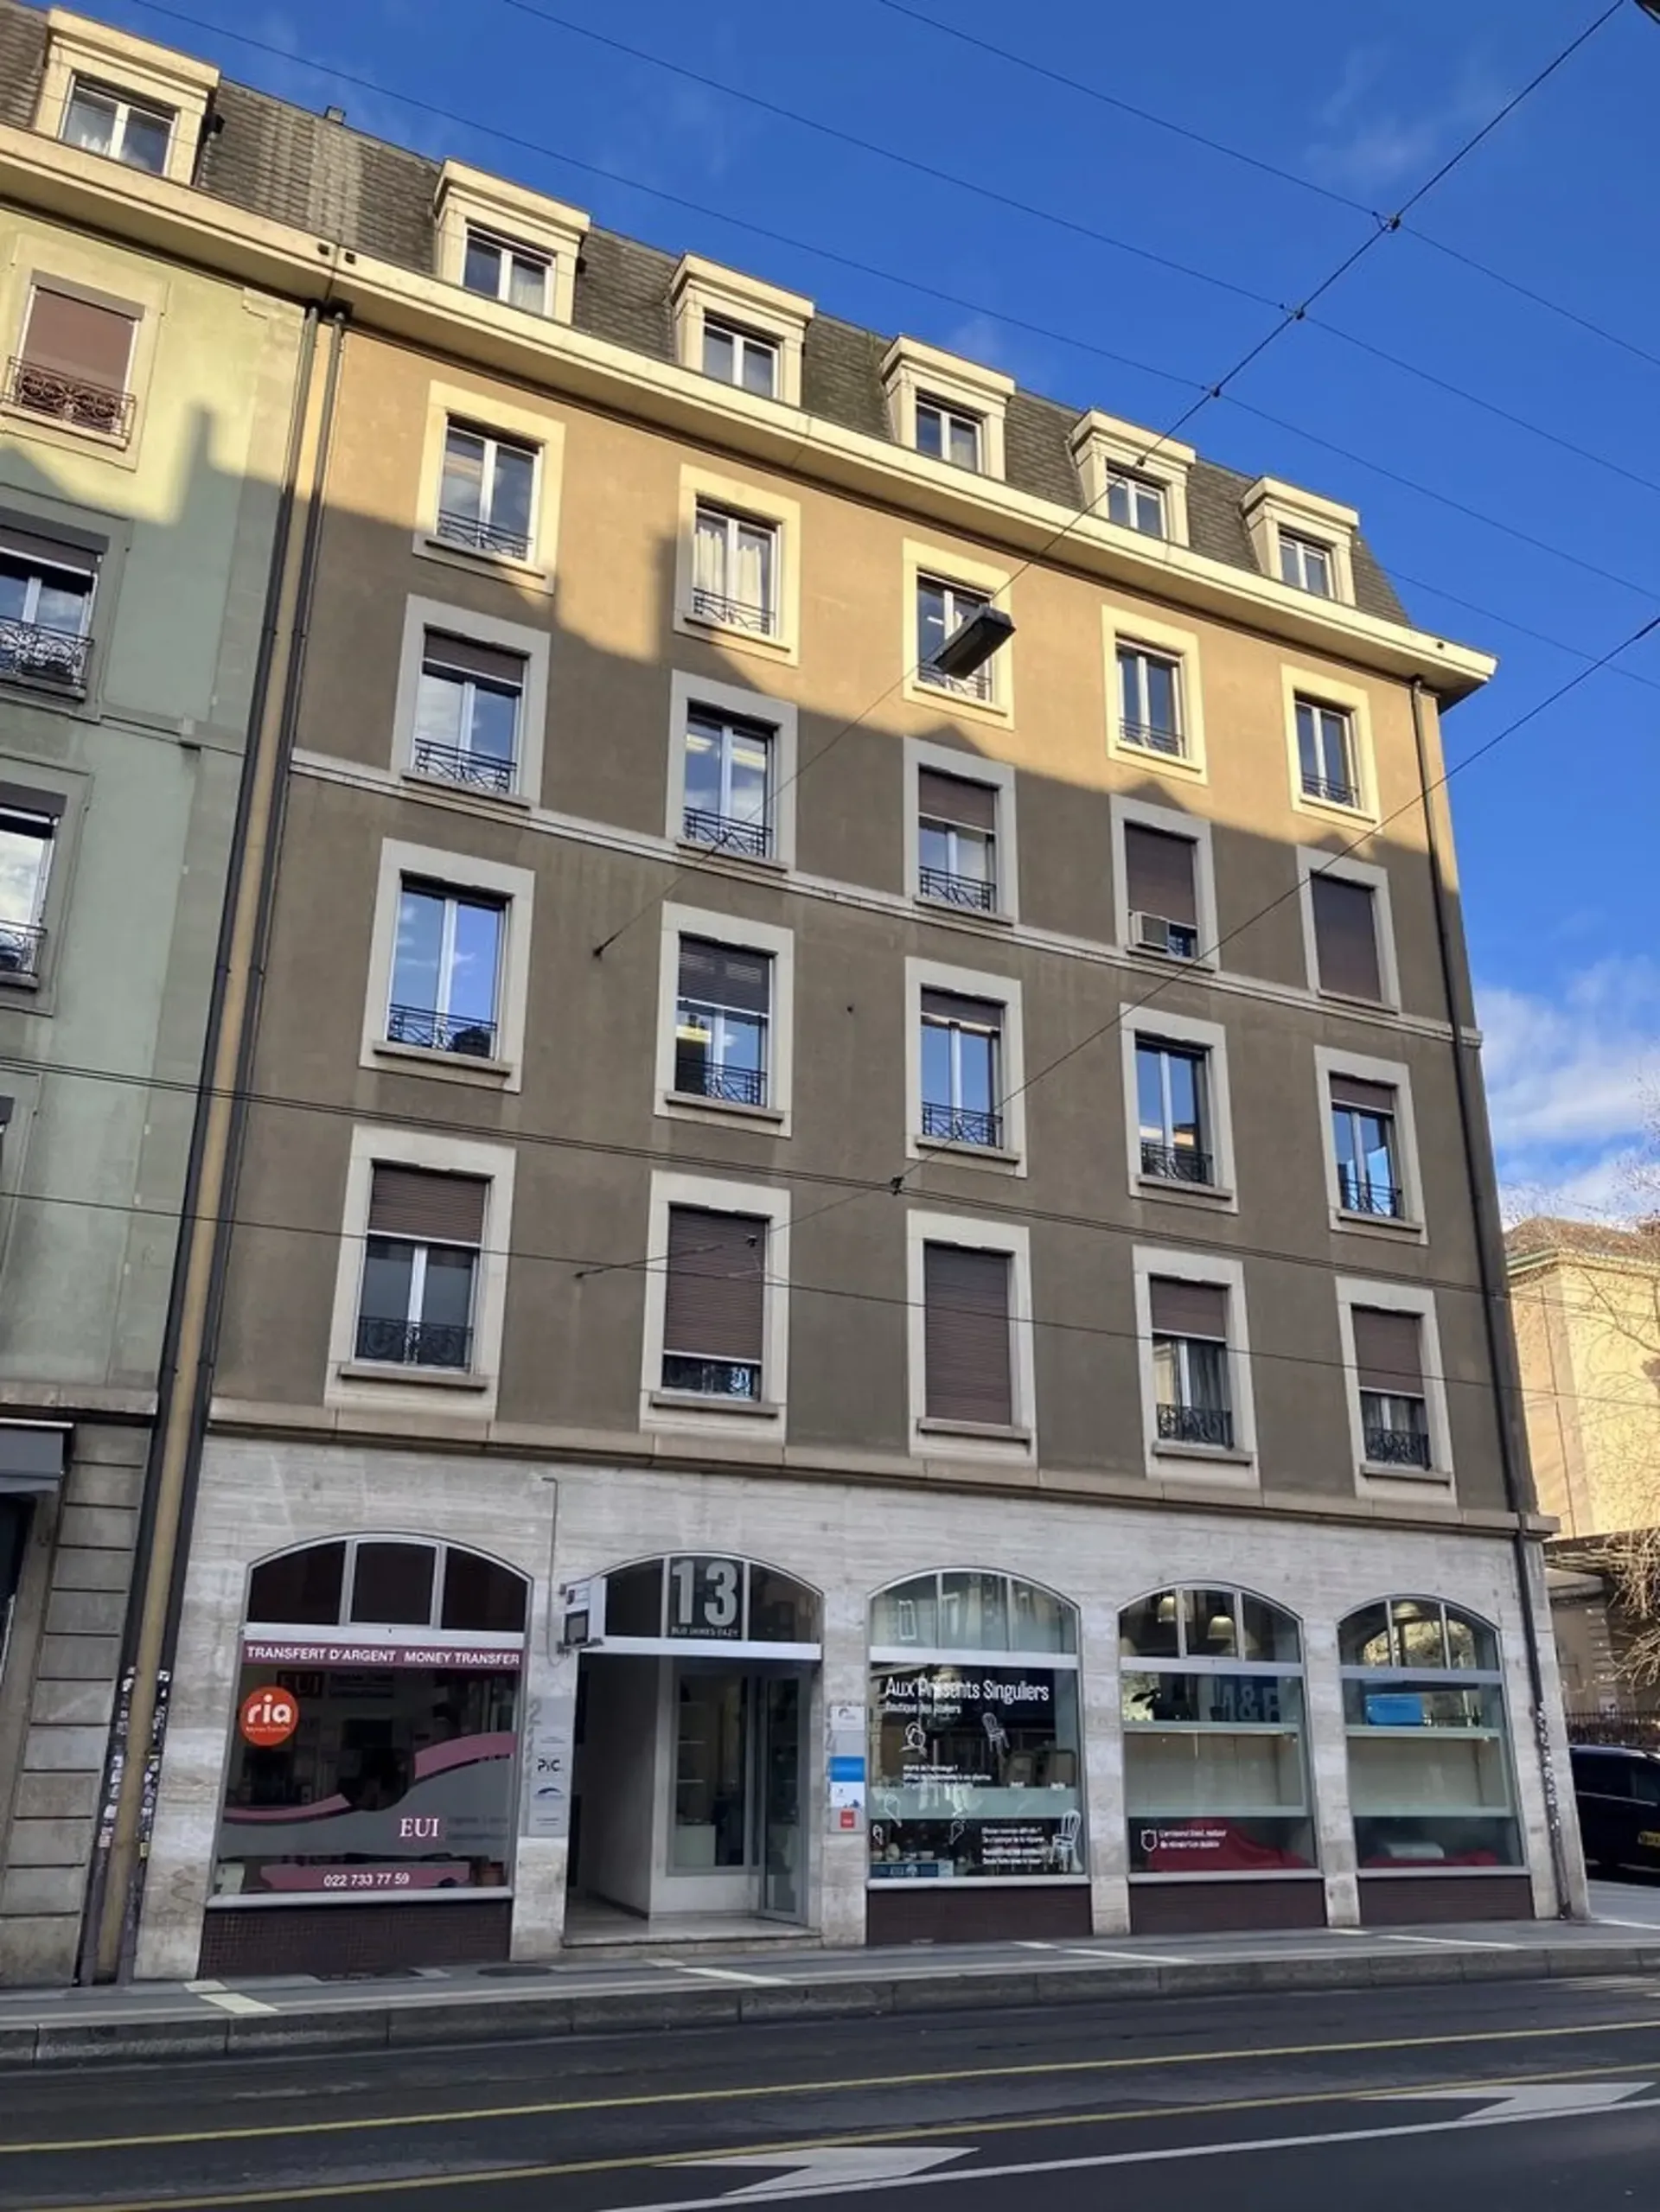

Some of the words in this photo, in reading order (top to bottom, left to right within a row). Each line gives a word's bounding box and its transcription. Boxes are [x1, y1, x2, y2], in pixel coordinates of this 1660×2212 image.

[671, 1559, 737, 1627] 13
[246, 1646, 327, 1660] TRANSFERT
[329, 1648, 396, 1661] D'ARGENT
[404, 1652, 452, 1663] MONEY
[455, 1653, 519, 1664] TRANSFER
[885, 1677, 916, 1698] Aux
[982, 1680, 1050, 1705] Singuliers
[247, 1693, 292, 1724] ria
[399, 1818, 439, 1837] EUI
[323, 1874, 348, 1887] 022
[350, 1873, 374, 1886] 733
[377, 1872, 392, 1884] 77
